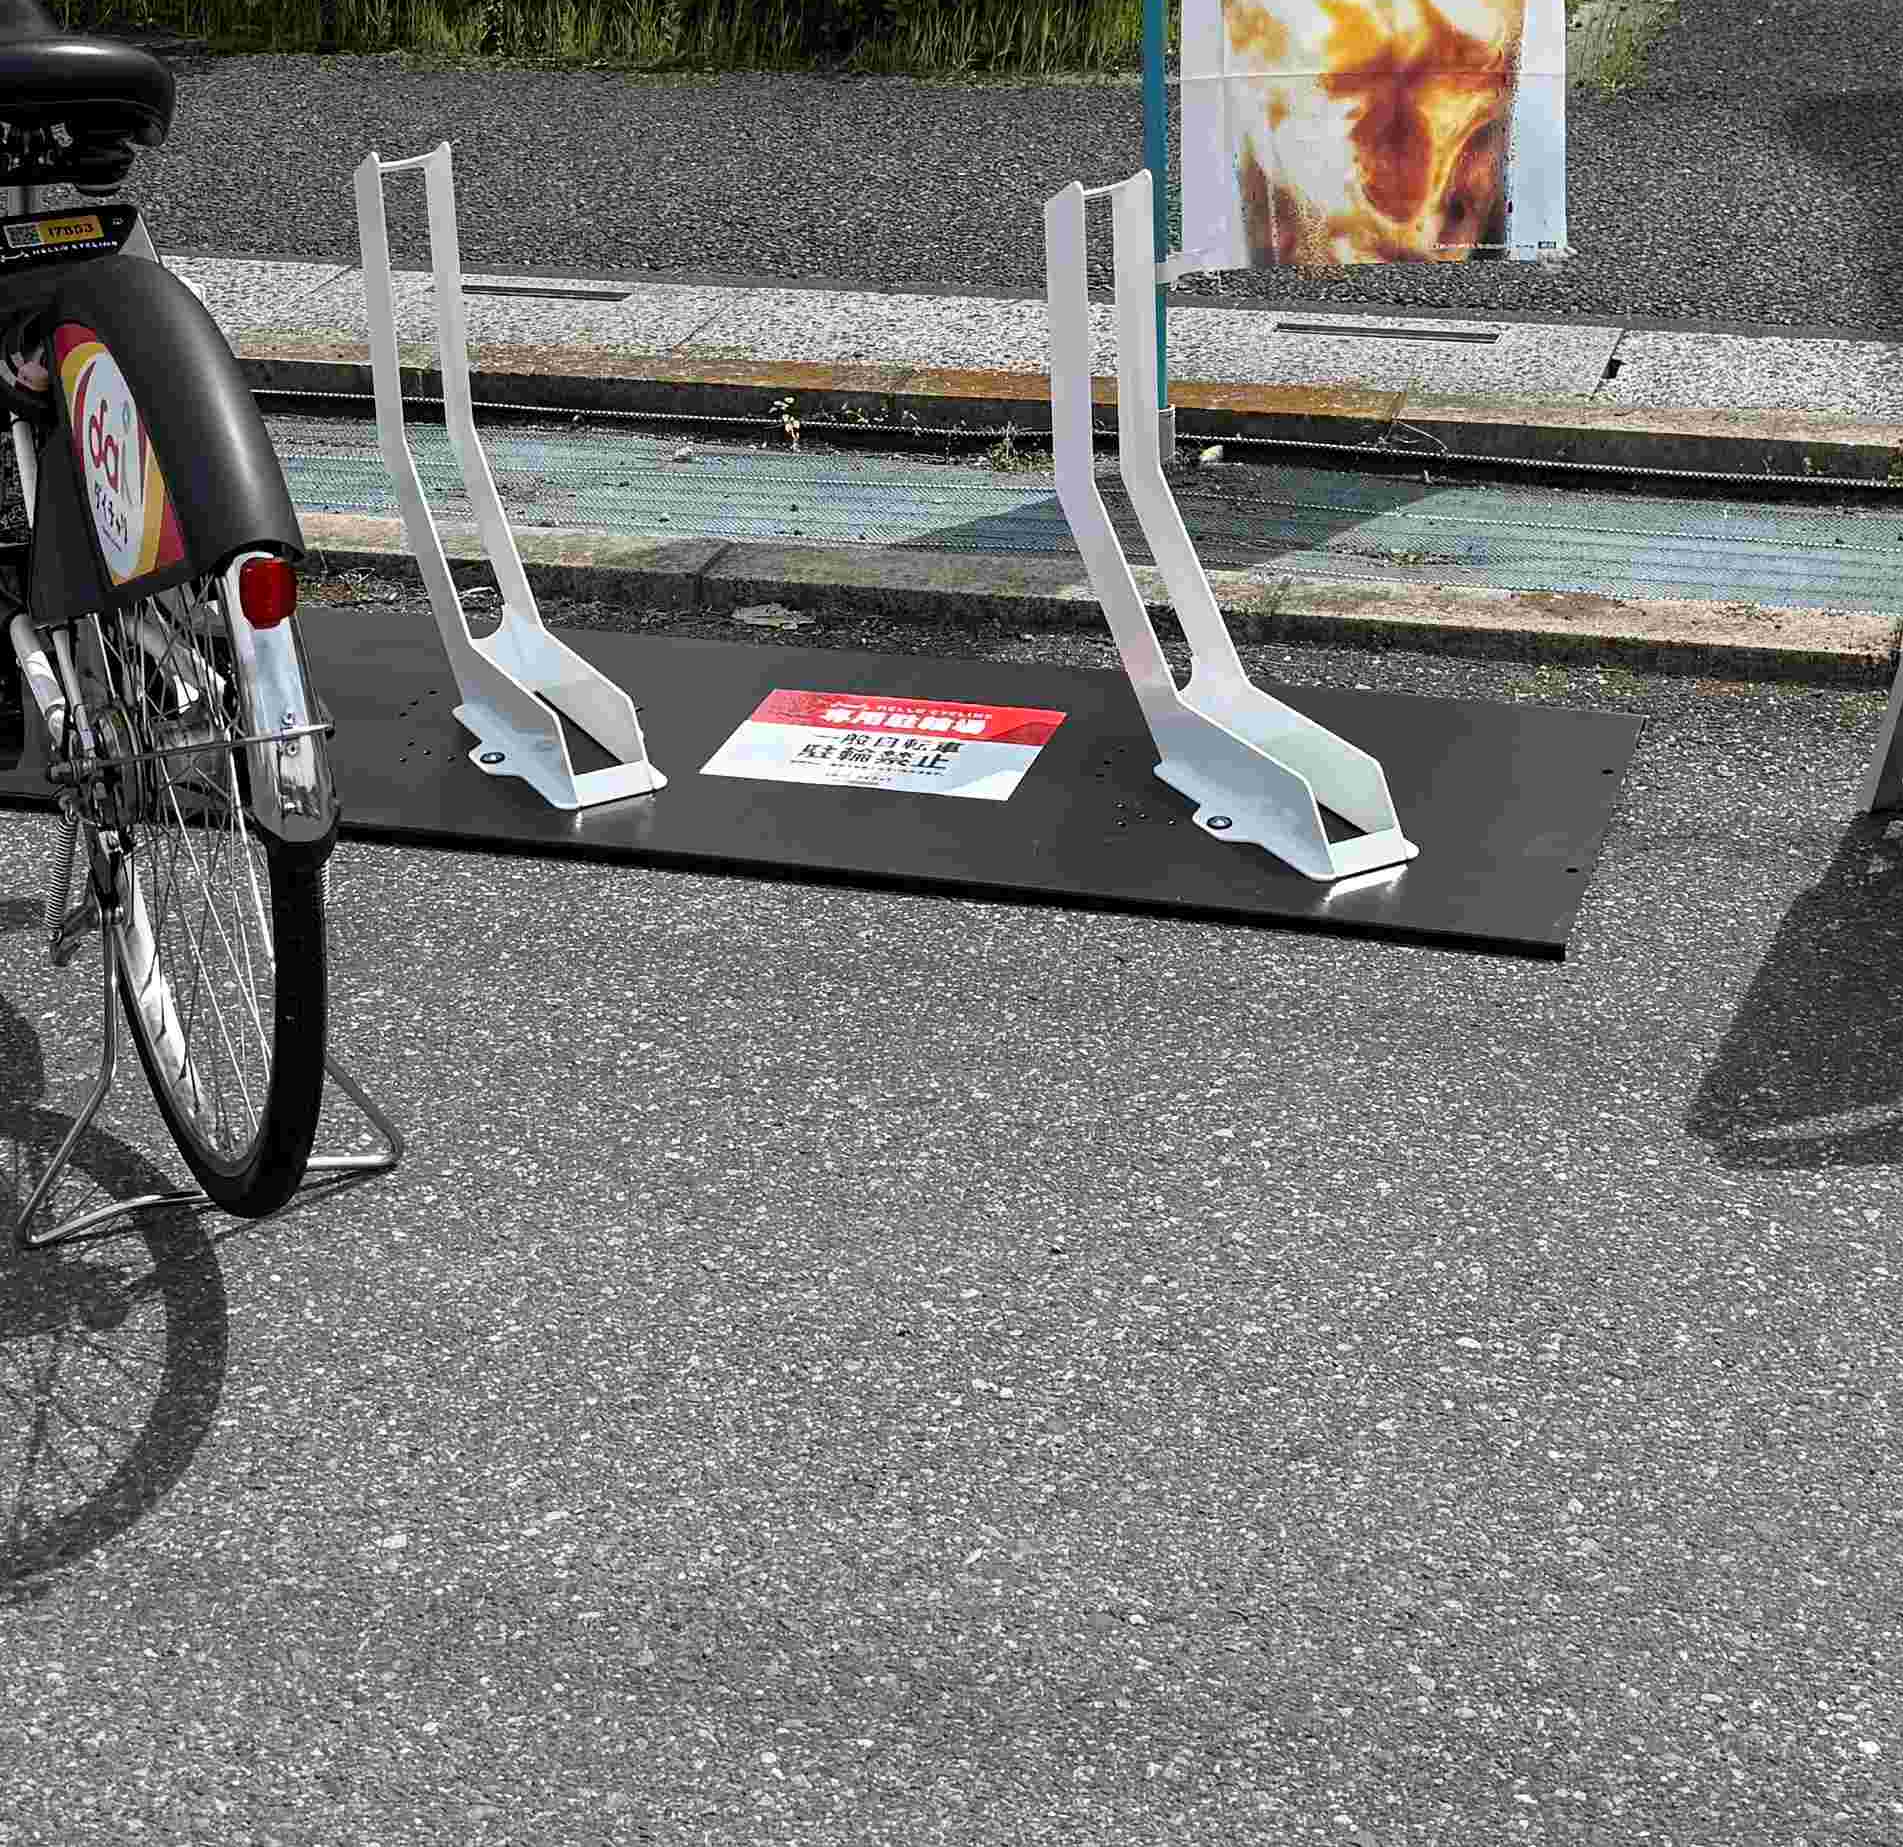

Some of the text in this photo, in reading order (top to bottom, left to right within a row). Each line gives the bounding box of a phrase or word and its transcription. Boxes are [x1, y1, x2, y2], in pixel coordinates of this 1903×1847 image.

[812, 732, 964, 754] 一般自転車
[797, 742, 951, 771] 駐輪禁止
